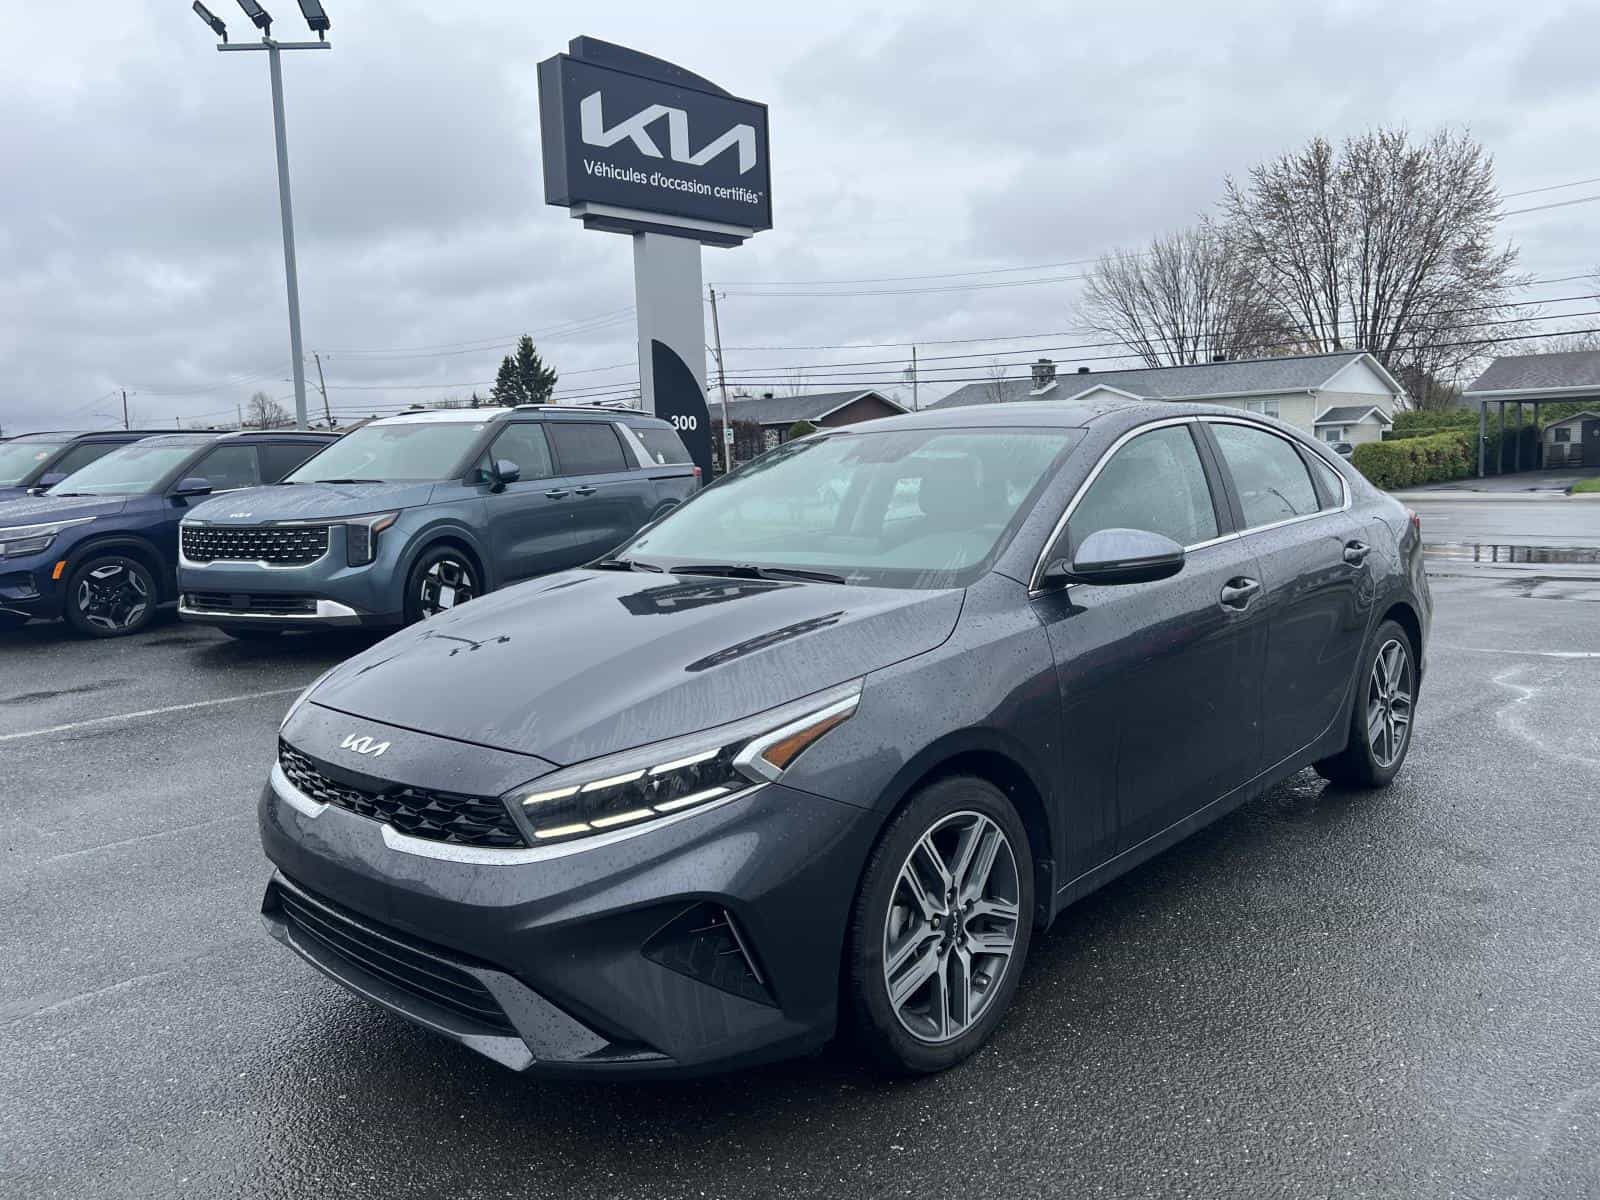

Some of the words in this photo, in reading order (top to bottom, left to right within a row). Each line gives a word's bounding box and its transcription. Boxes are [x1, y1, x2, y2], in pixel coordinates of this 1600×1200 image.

[580, 90, 757, 175] KIA
[583, 159, 647, 185] Véhicules
[650, 171, 712, 197] d'occasion
[671, 415, 697, 431] 300
[340, 733, 391, 757] KIA
